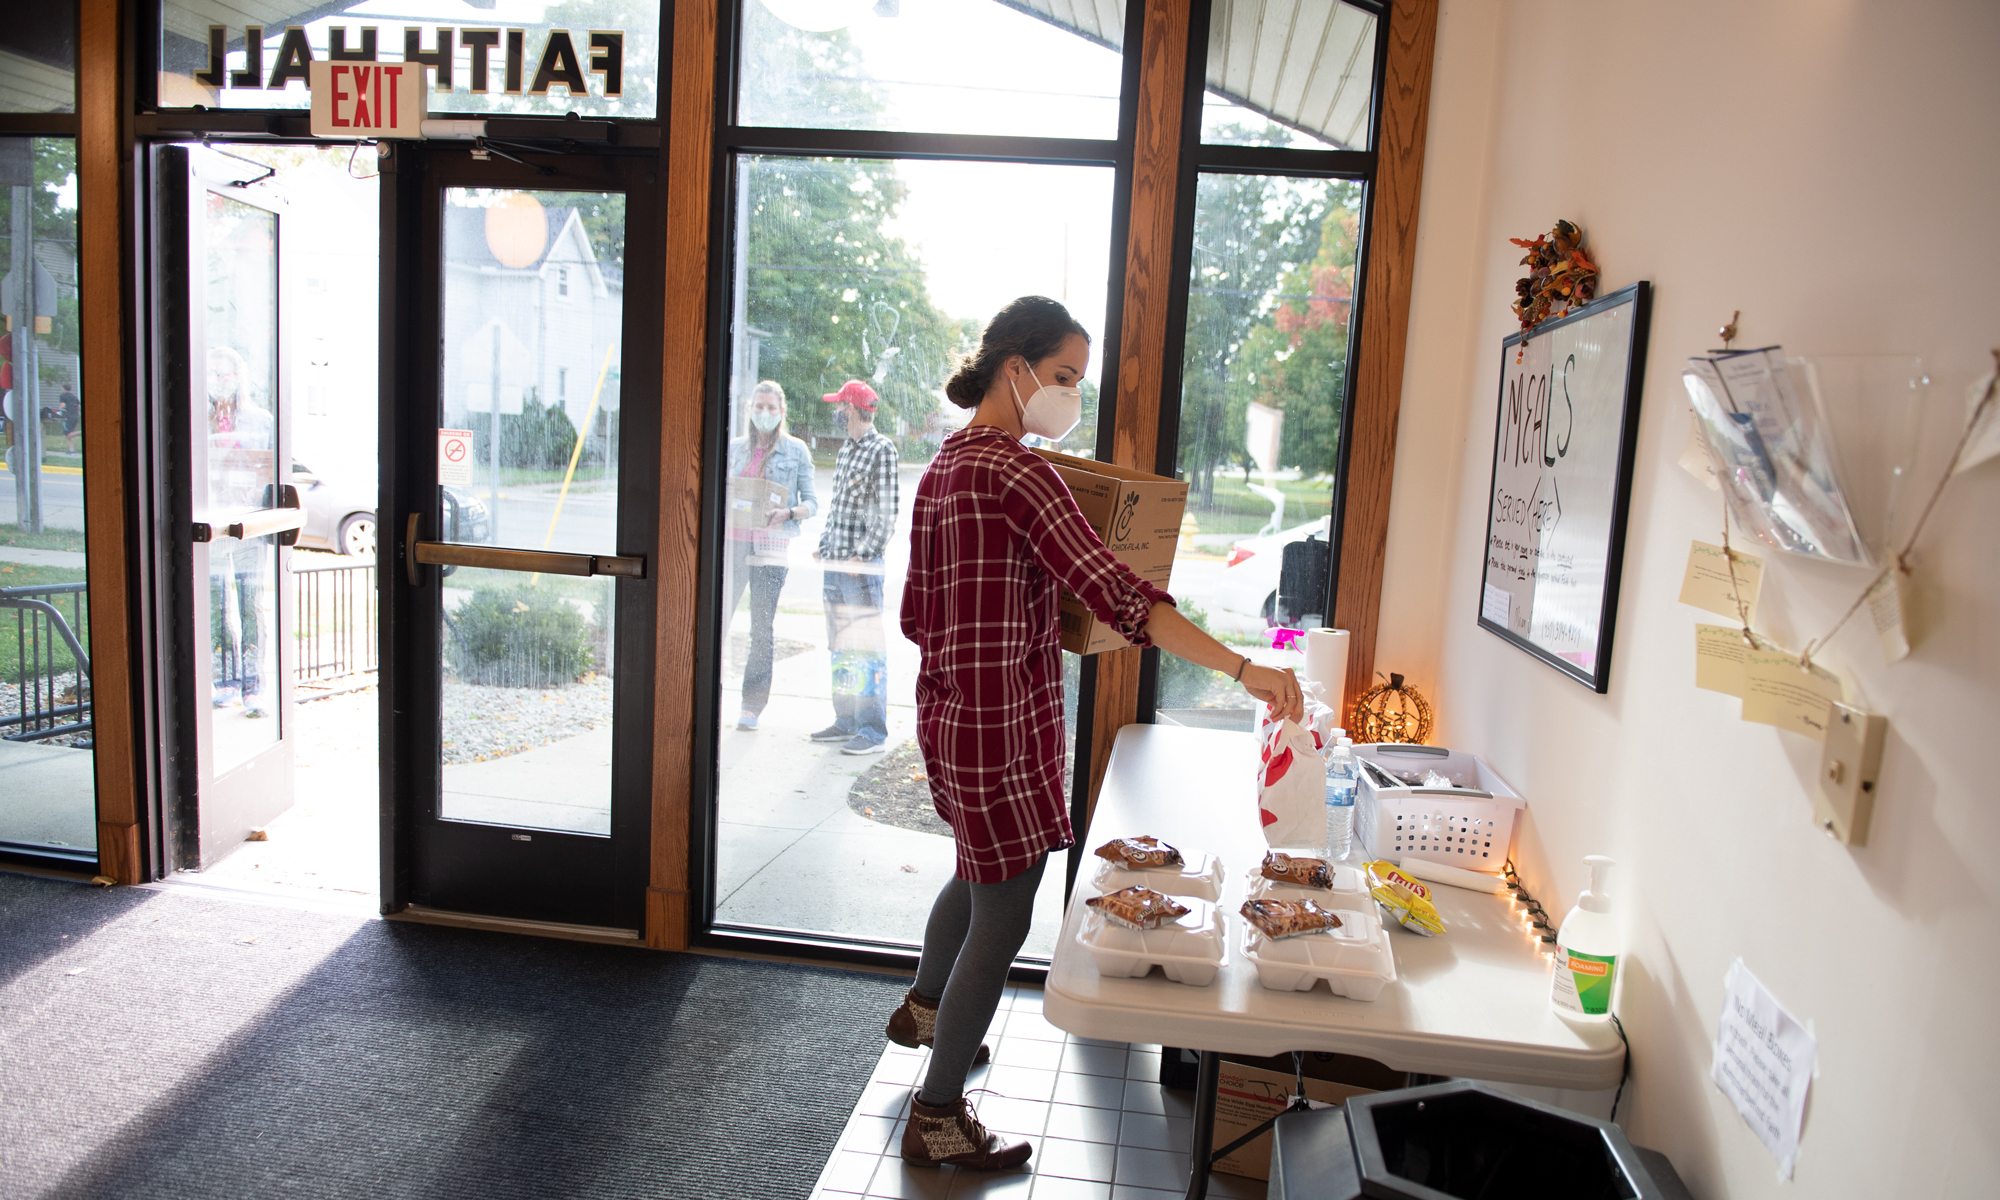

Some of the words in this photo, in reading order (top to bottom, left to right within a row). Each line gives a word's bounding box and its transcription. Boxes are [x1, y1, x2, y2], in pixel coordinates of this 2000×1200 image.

[330, 65, 403, 129] EXIT
[1502, 353, 1576, 468] MEALS
[1495, 488, 1527, 527] SERVED
[1570, 959, 1605, 973] FOAMING
[1219, 1072, 1244, 1083] Gordon
[1217, 1095, 1231, 1103] Extra
[1231, 1098, 1244, 1106] Wide
